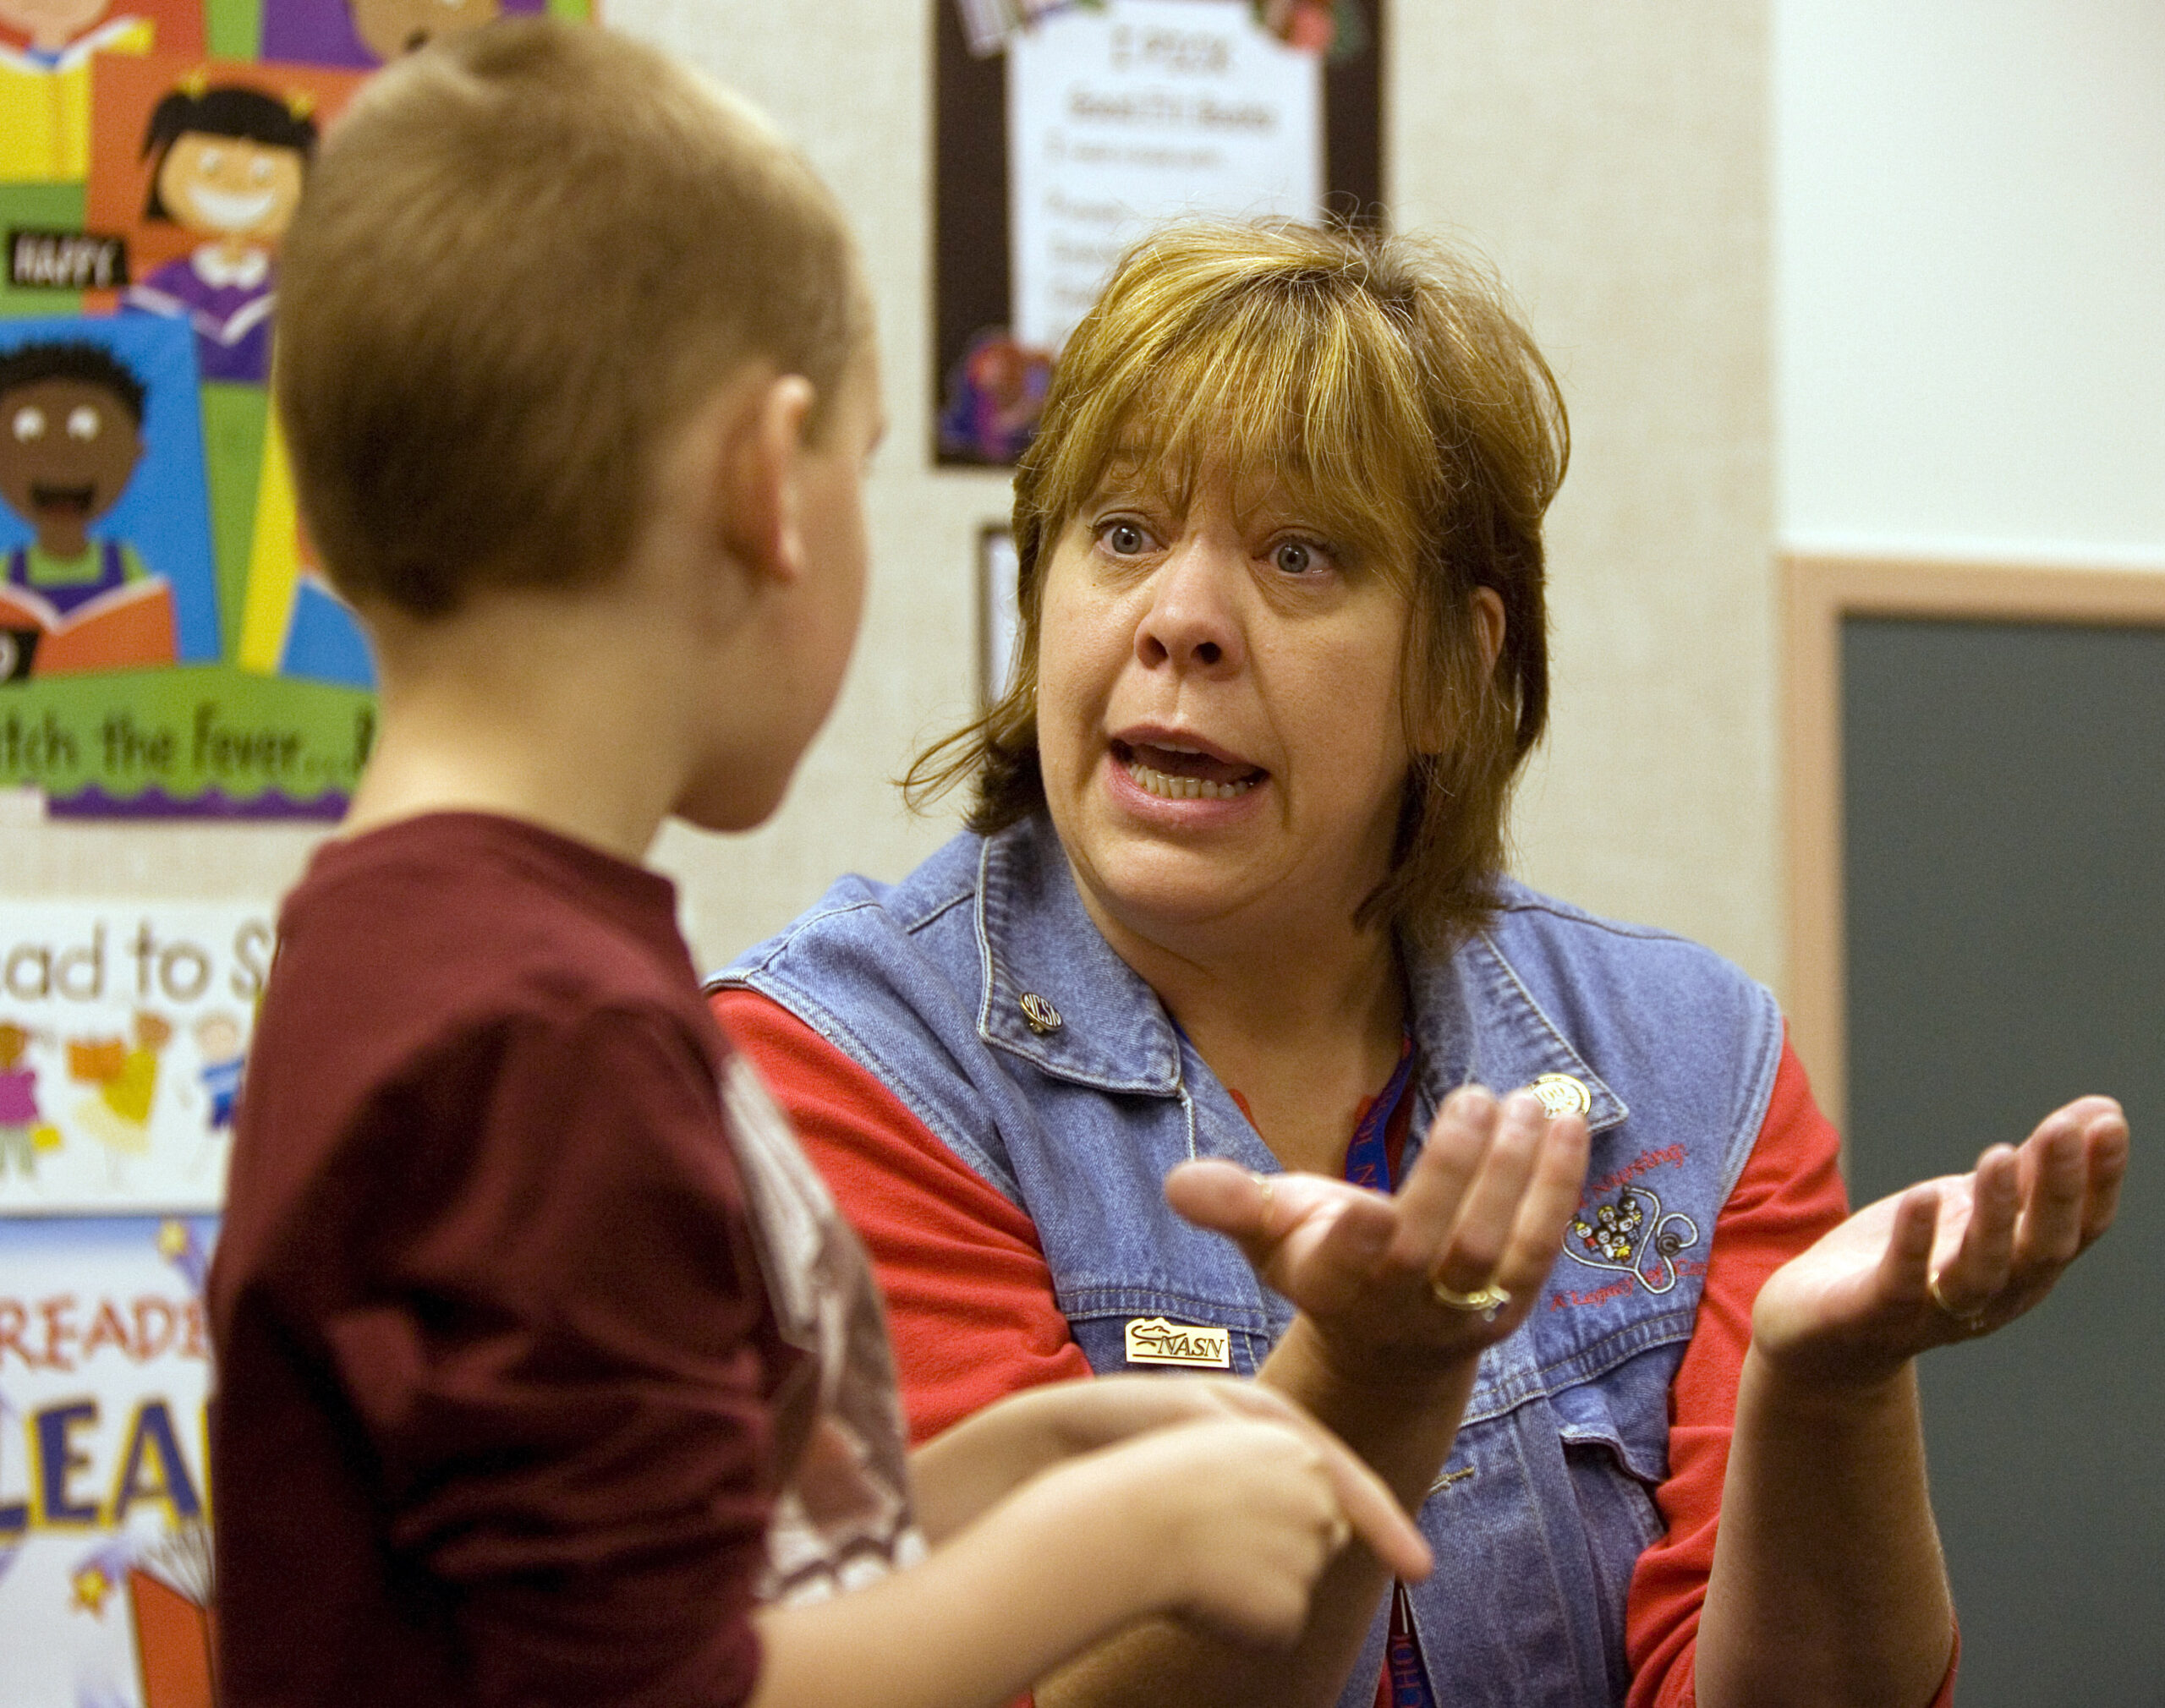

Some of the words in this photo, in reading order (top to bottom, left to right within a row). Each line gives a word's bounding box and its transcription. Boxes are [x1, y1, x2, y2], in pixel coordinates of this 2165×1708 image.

[0, 709, 78, 771] tch
[101, 712, 173, 775] the
[129, 920, 212, 1005] to
[1157, 1335, 1225, 1358] NASN
